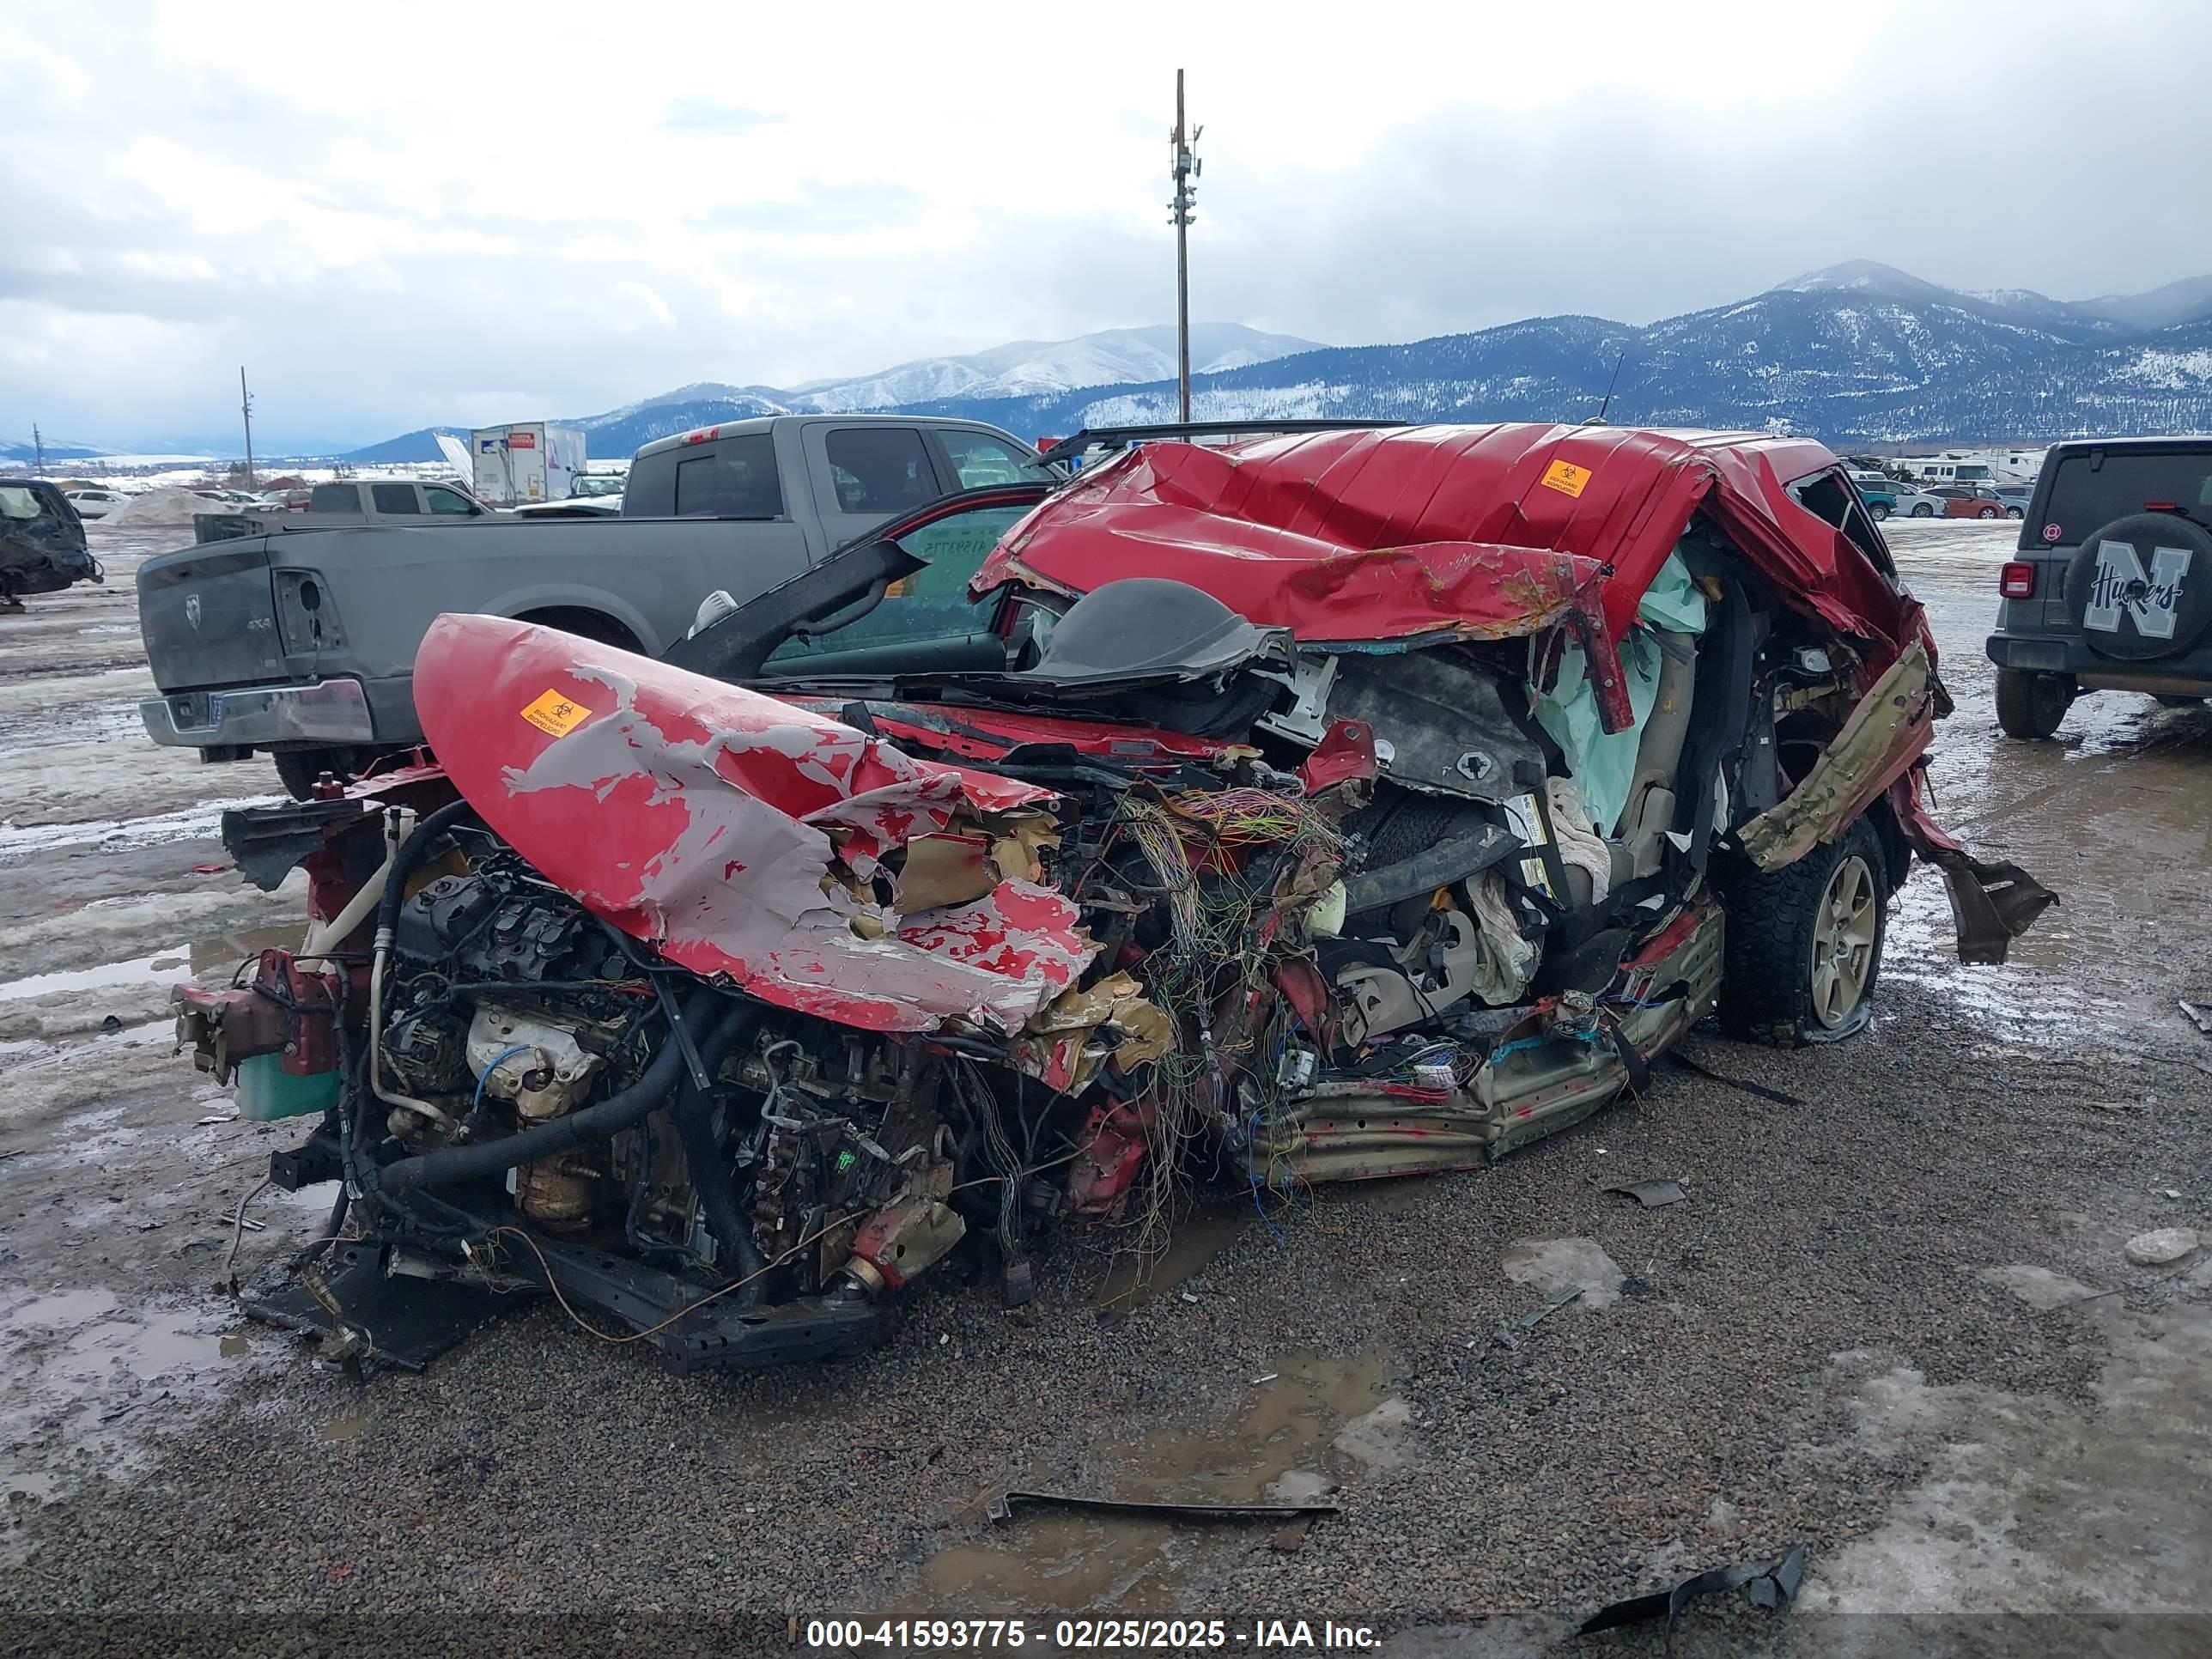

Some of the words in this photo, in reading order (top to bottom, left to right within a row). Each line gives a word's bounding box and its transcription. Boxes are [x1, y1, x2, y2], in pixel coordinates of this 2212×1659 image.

[1549, 475, 1578, 489] BIOHAZARD
[526, 713, 561, 735] BIOPELIGRO
[533, 708, 568, 730] BIOHAZARD
